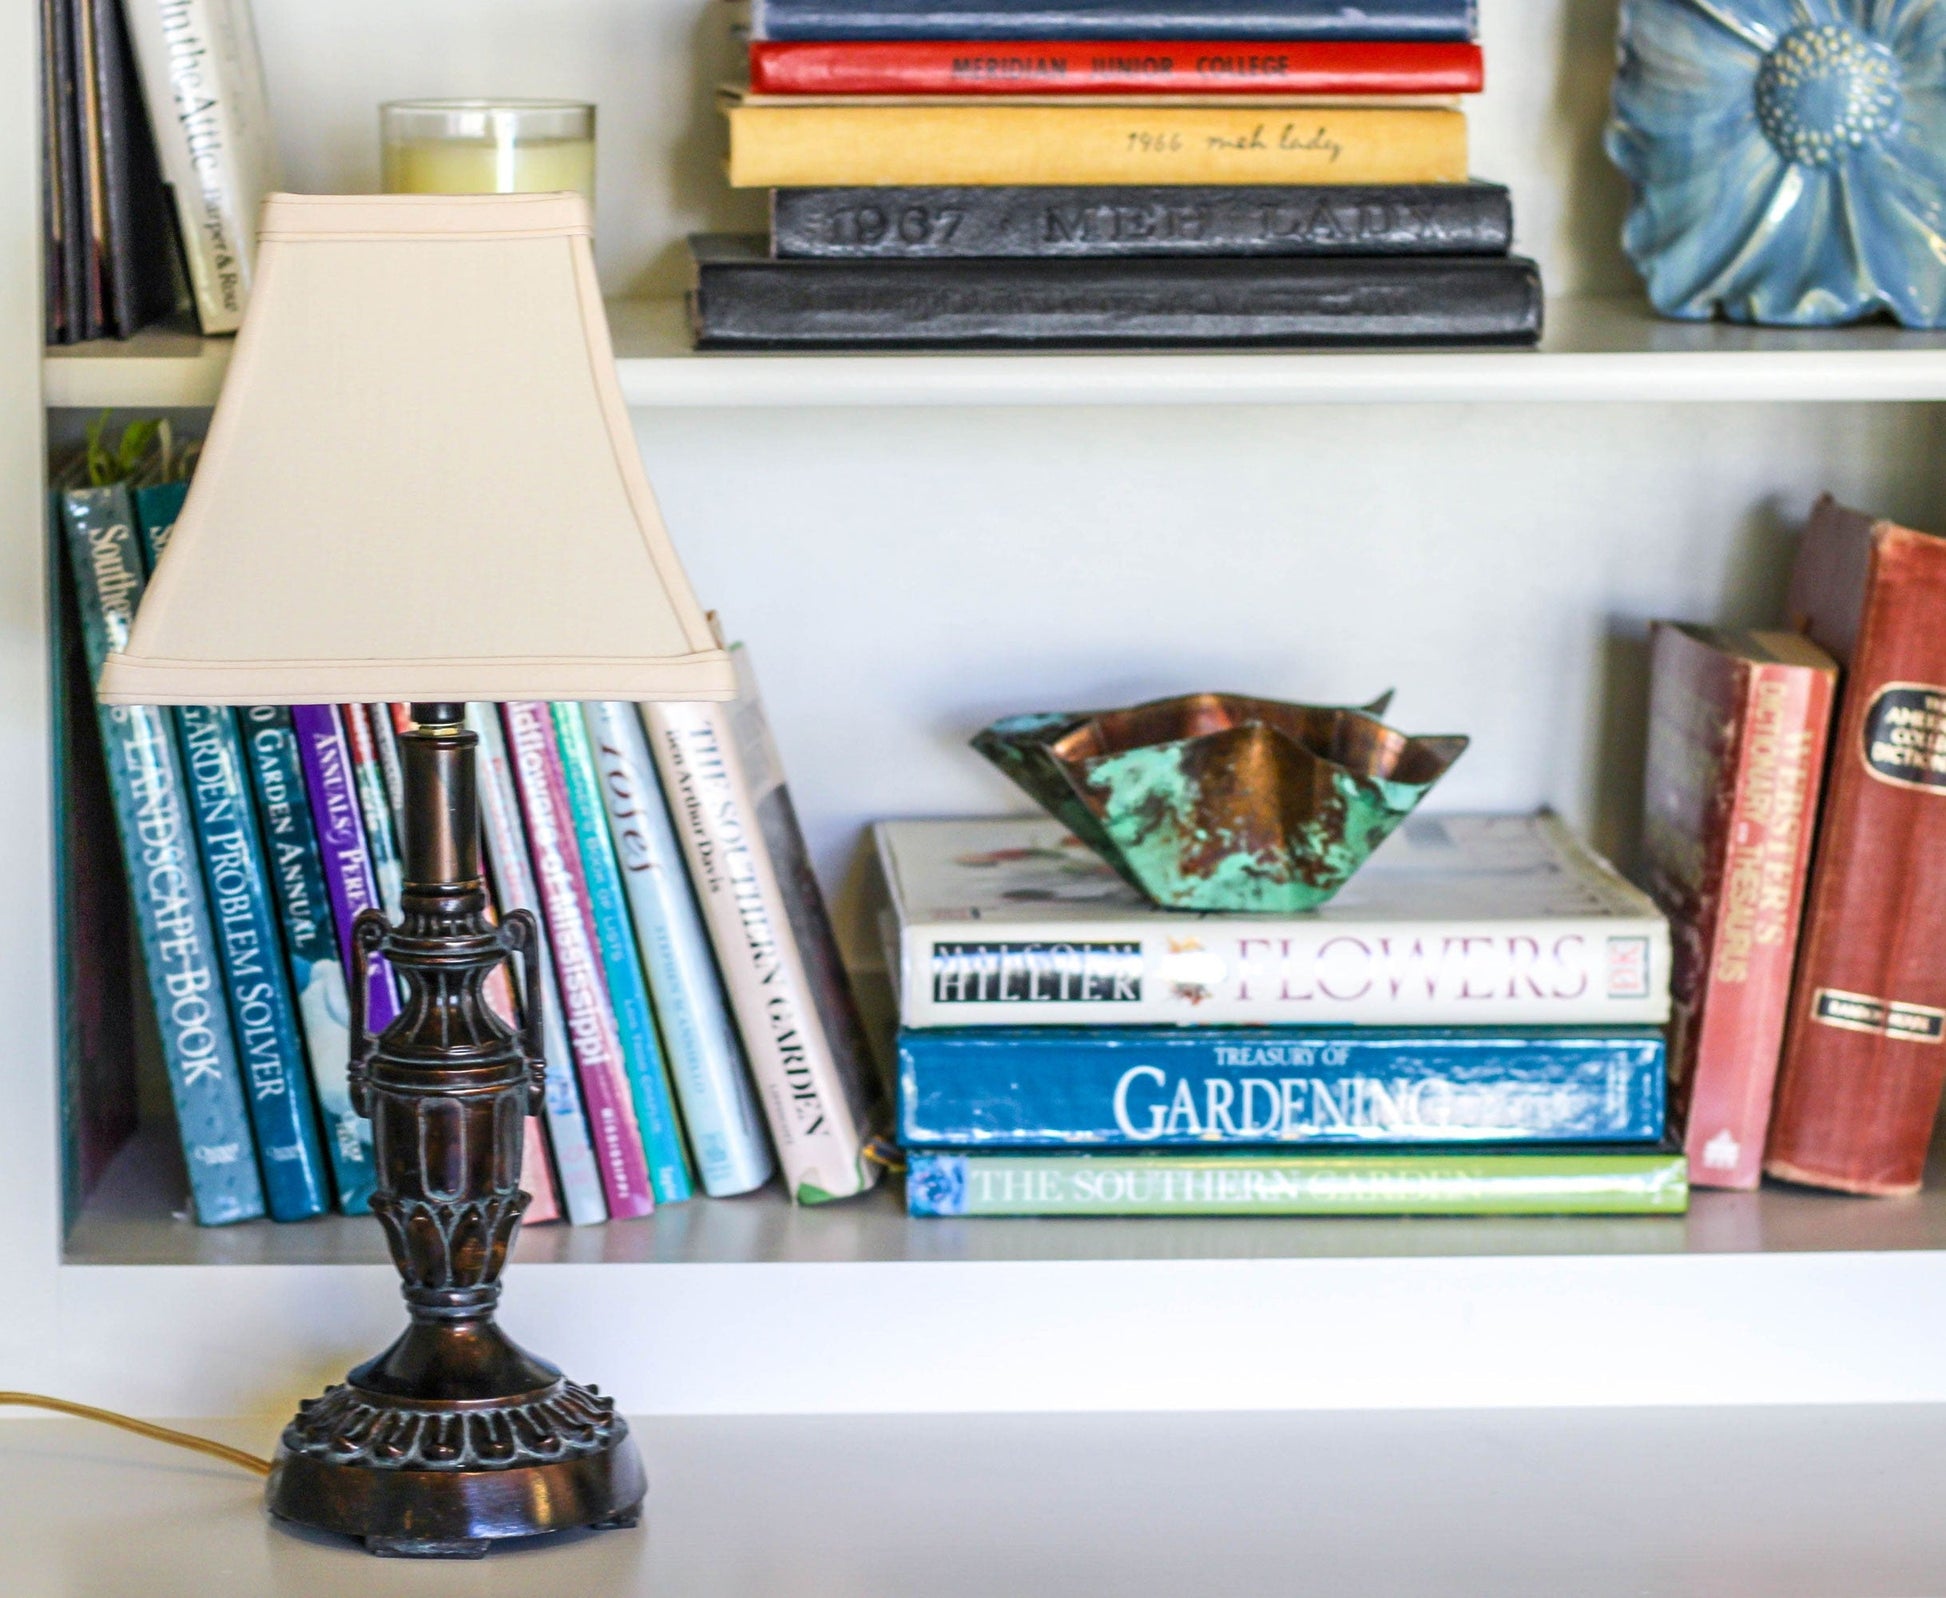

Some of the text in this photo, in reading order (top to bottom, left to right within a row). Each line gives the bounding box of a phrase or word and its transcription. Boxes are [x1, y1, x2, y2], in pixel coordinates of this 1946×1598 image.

[951, 55, 1290, 81] MERIDIAN JUNIOR COLLEGE
[174, 97, 222, 173] Attic
[1126, 131, 1184, 153] 1966
[1278, 122, 1343, 163] lady
[831, 204, 965, 245] 1967
[313, 732, 351, 831] ANNUALS
[254, 728, 294, 834] GARDEN
[276, 842, 316, 948] ANNUAL
[697, 840, 724, 893] Davis
[123, 733, 198, 962] LANDSCAPE
[165, 965, 222, 1086] BOOK
[207, 828, 263, 976] PROBLEM
[235, 982, 285, 1101] SOLVER
[1236, 935, 1588, 1001] FLOWERS
[768, 997, 830, 1137] GARDEN
[1214, 1047, 1350, 1067] TREASURY OF
[1113, 1064, 1450, 1141] GARDENING
[971, 1168, 1063, 1201] THE
[1072, 1168, 1300, 1202] SOUTHERN
